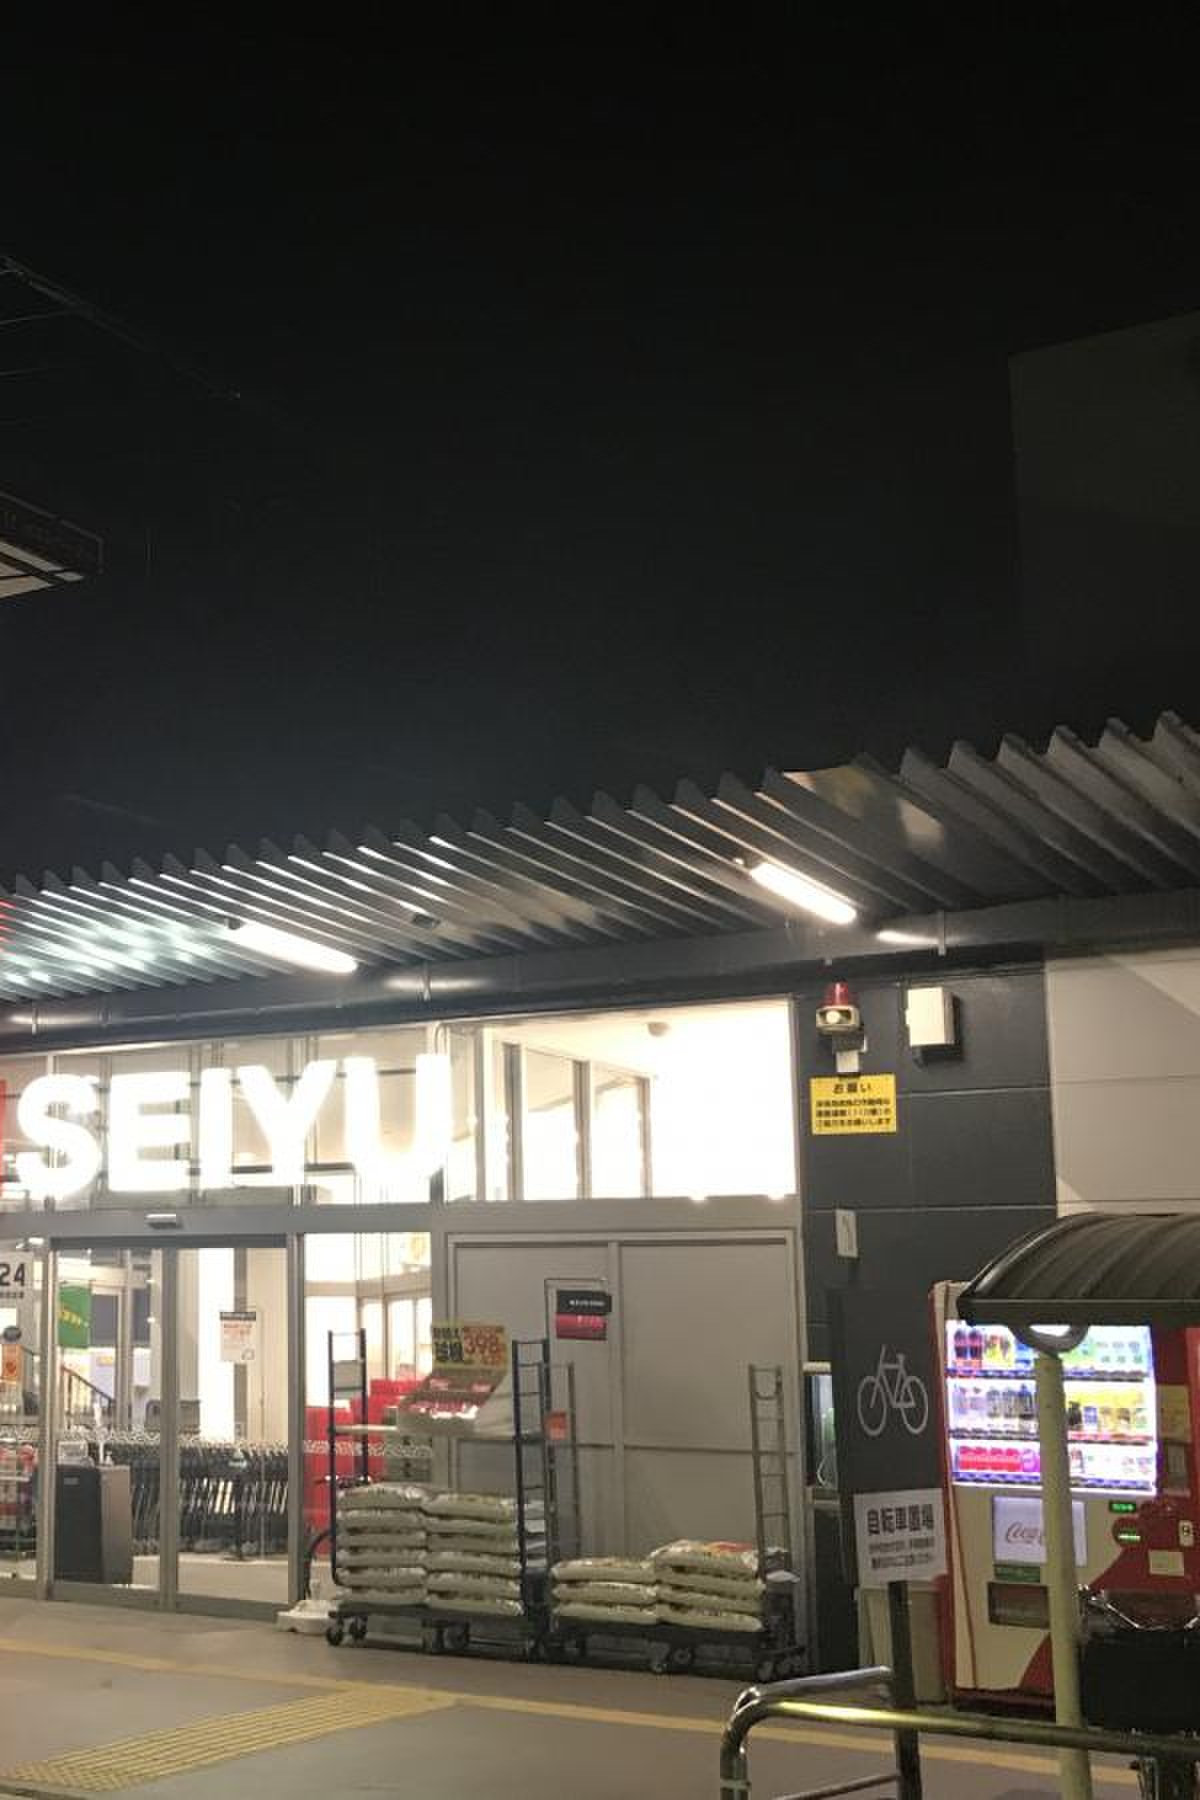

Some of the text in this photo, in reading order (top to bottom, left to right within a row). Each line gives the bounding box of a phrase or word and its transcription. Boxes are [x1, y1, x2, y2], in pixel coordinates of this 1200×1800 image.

[15, 1053, 451, 1201] SEIYU
[0, 1263, 25, 1287] 24
[867, 1504, 934, 1535] 自転車置場
